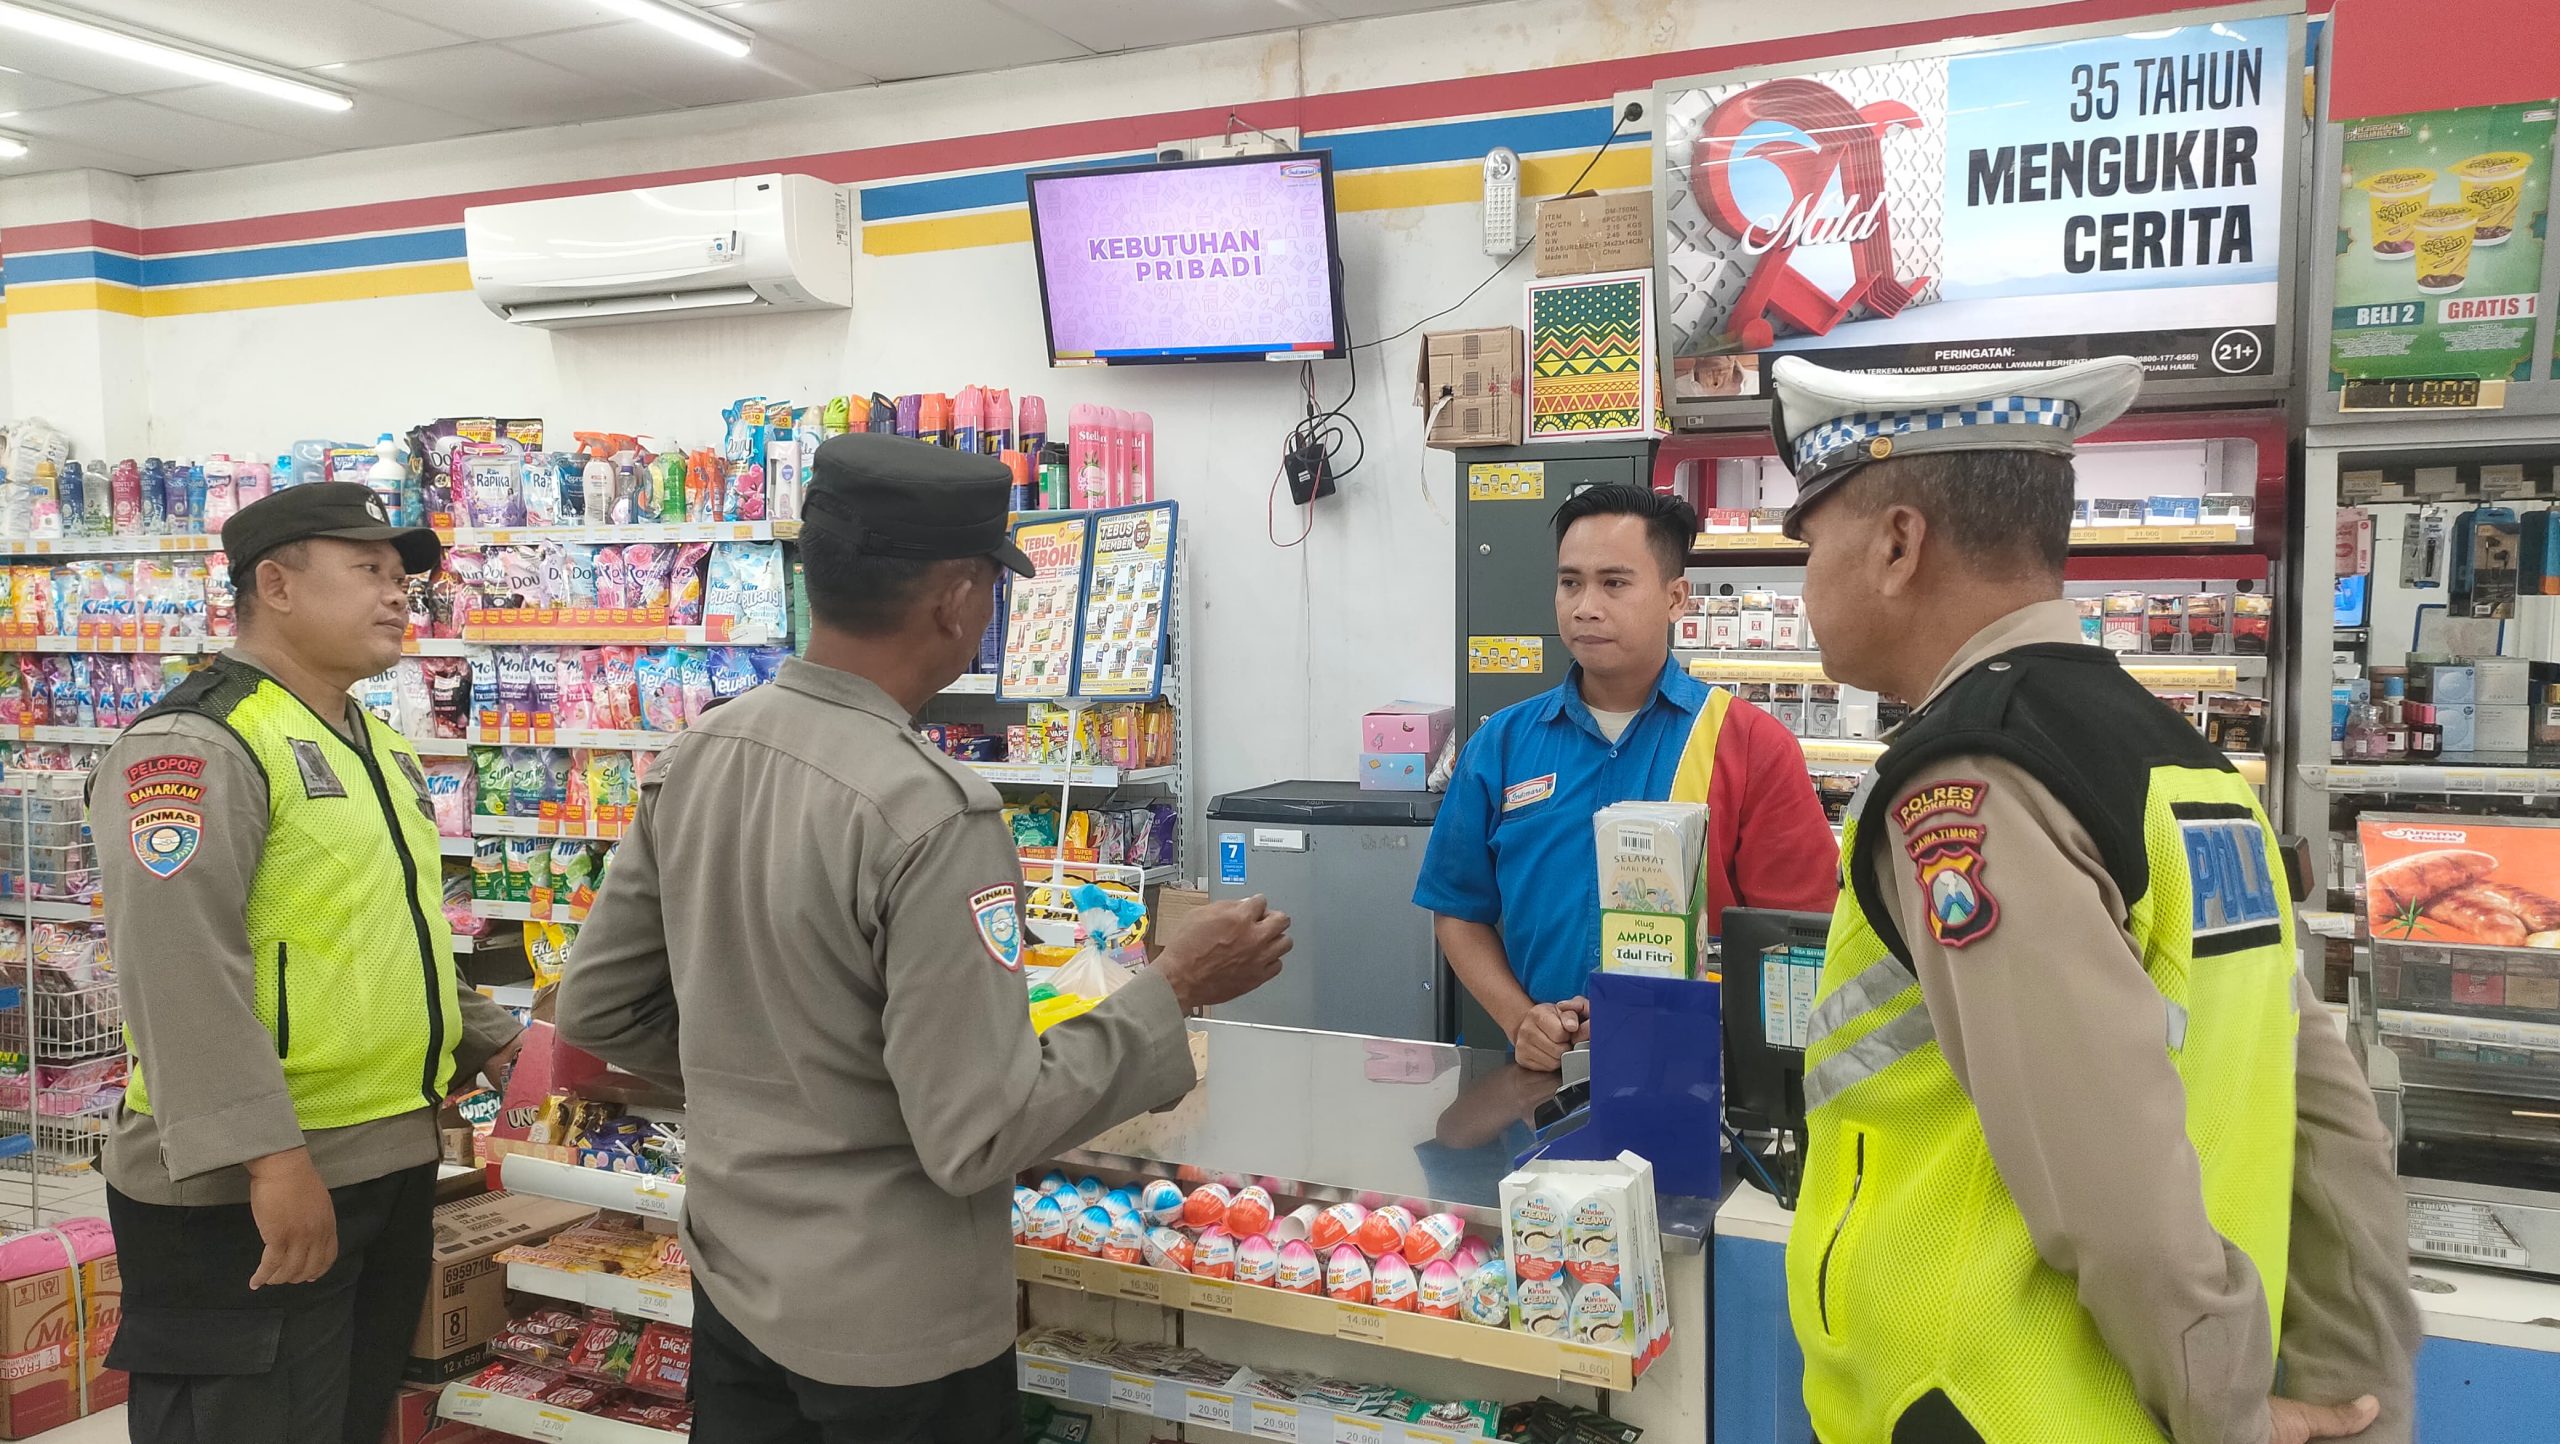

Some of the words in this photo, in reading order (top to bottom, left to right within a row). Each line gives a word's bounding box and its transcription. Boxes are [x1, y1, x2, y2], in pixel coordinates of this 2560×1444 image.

[2071, 62, 2119, 122] 35
[2133, 48, 2262, 116] TAHUN
[1968, 126, 2258, 207] MENGUKIR
[1742, 192, 1887, 256] Mild
[1088, 229, 1260, 261] KEBUTUHAN
[2064, 205, 2253, 274] CERITA
[1136, 255, 1262, 282] PRIBADI
[2356, 306, 2399, 326] BELI
[2402, 304, 2415, 323] 2
[2447, 298, 2520, 320] GRATIS
[2527, 297, 2536, 314] 1
[1935, 347, 2016, 360] PERINGATAN:
[2219, 343, 2254, 360] 21+
[1867, 365, 1902, 374] TERKENA
[1904, 364, 1937, 373] KANKER
[2005, 360, 2043, 369] LAYANAN
[2170, 362, 2197, 371] HAMIL
[1100, 521, 1134, 541] TEBUS
[1024, 536, 1055, 551] TEBUS
[1098, 538, 1133, 553] MEMBER
[128, 758, 200, 781] PELOPOR
[131, 784, 199, 803] BAHARKAM
[1901, 785, 1975, 821] POLRES
[1913, 829, 1938, 853] JAWA
[1937, 826, 1979, 842] TIMUR
[1229, 844, 1238, 859] 7
[1614, 854, 1666, 867] SELAMAT
[1620, 865, 1638, 873] HARI
[1641, 865, 1663, 874] RAYA
[1634, 919, 1655, 931] Klug
[1617, 931, 1673, 946] AMPLOP
[1616, 949, 1643, 961] Idul
[1645, 950, 1673, 963] Fitri
[1527, 1200, 1551, 1211] kinder
[1580, 1206, 1605, 1216] kinder
[1519, 1208, 1556, 1223] CREAMY
[1574, 1214, 1612, 1226] CREAMY
[442, 1282, 465, 1299] LIME
[1527, 1286, 1551, 1296] kinder
[1202, 1293, 1233, 1306] 16.300
[1521, 1295, 1559, 1306] CREAMY
[1584, 1294, 1609, 1304] kinder
[1578, 1302, 1616, 1314] CREAMY
[450, 1312, 460, 1336] 8
[1346, 1314, 1380, 1328] 14.900
[444, 1361, 455, 1374] 12
[464, 1352, 481, 1367] 650
[1121, 1387, 1151, 1402] 20.900
[1198, 1404, 1230, 1419] 20.900
[1263, 1417, 1296, 1431] 20.900
